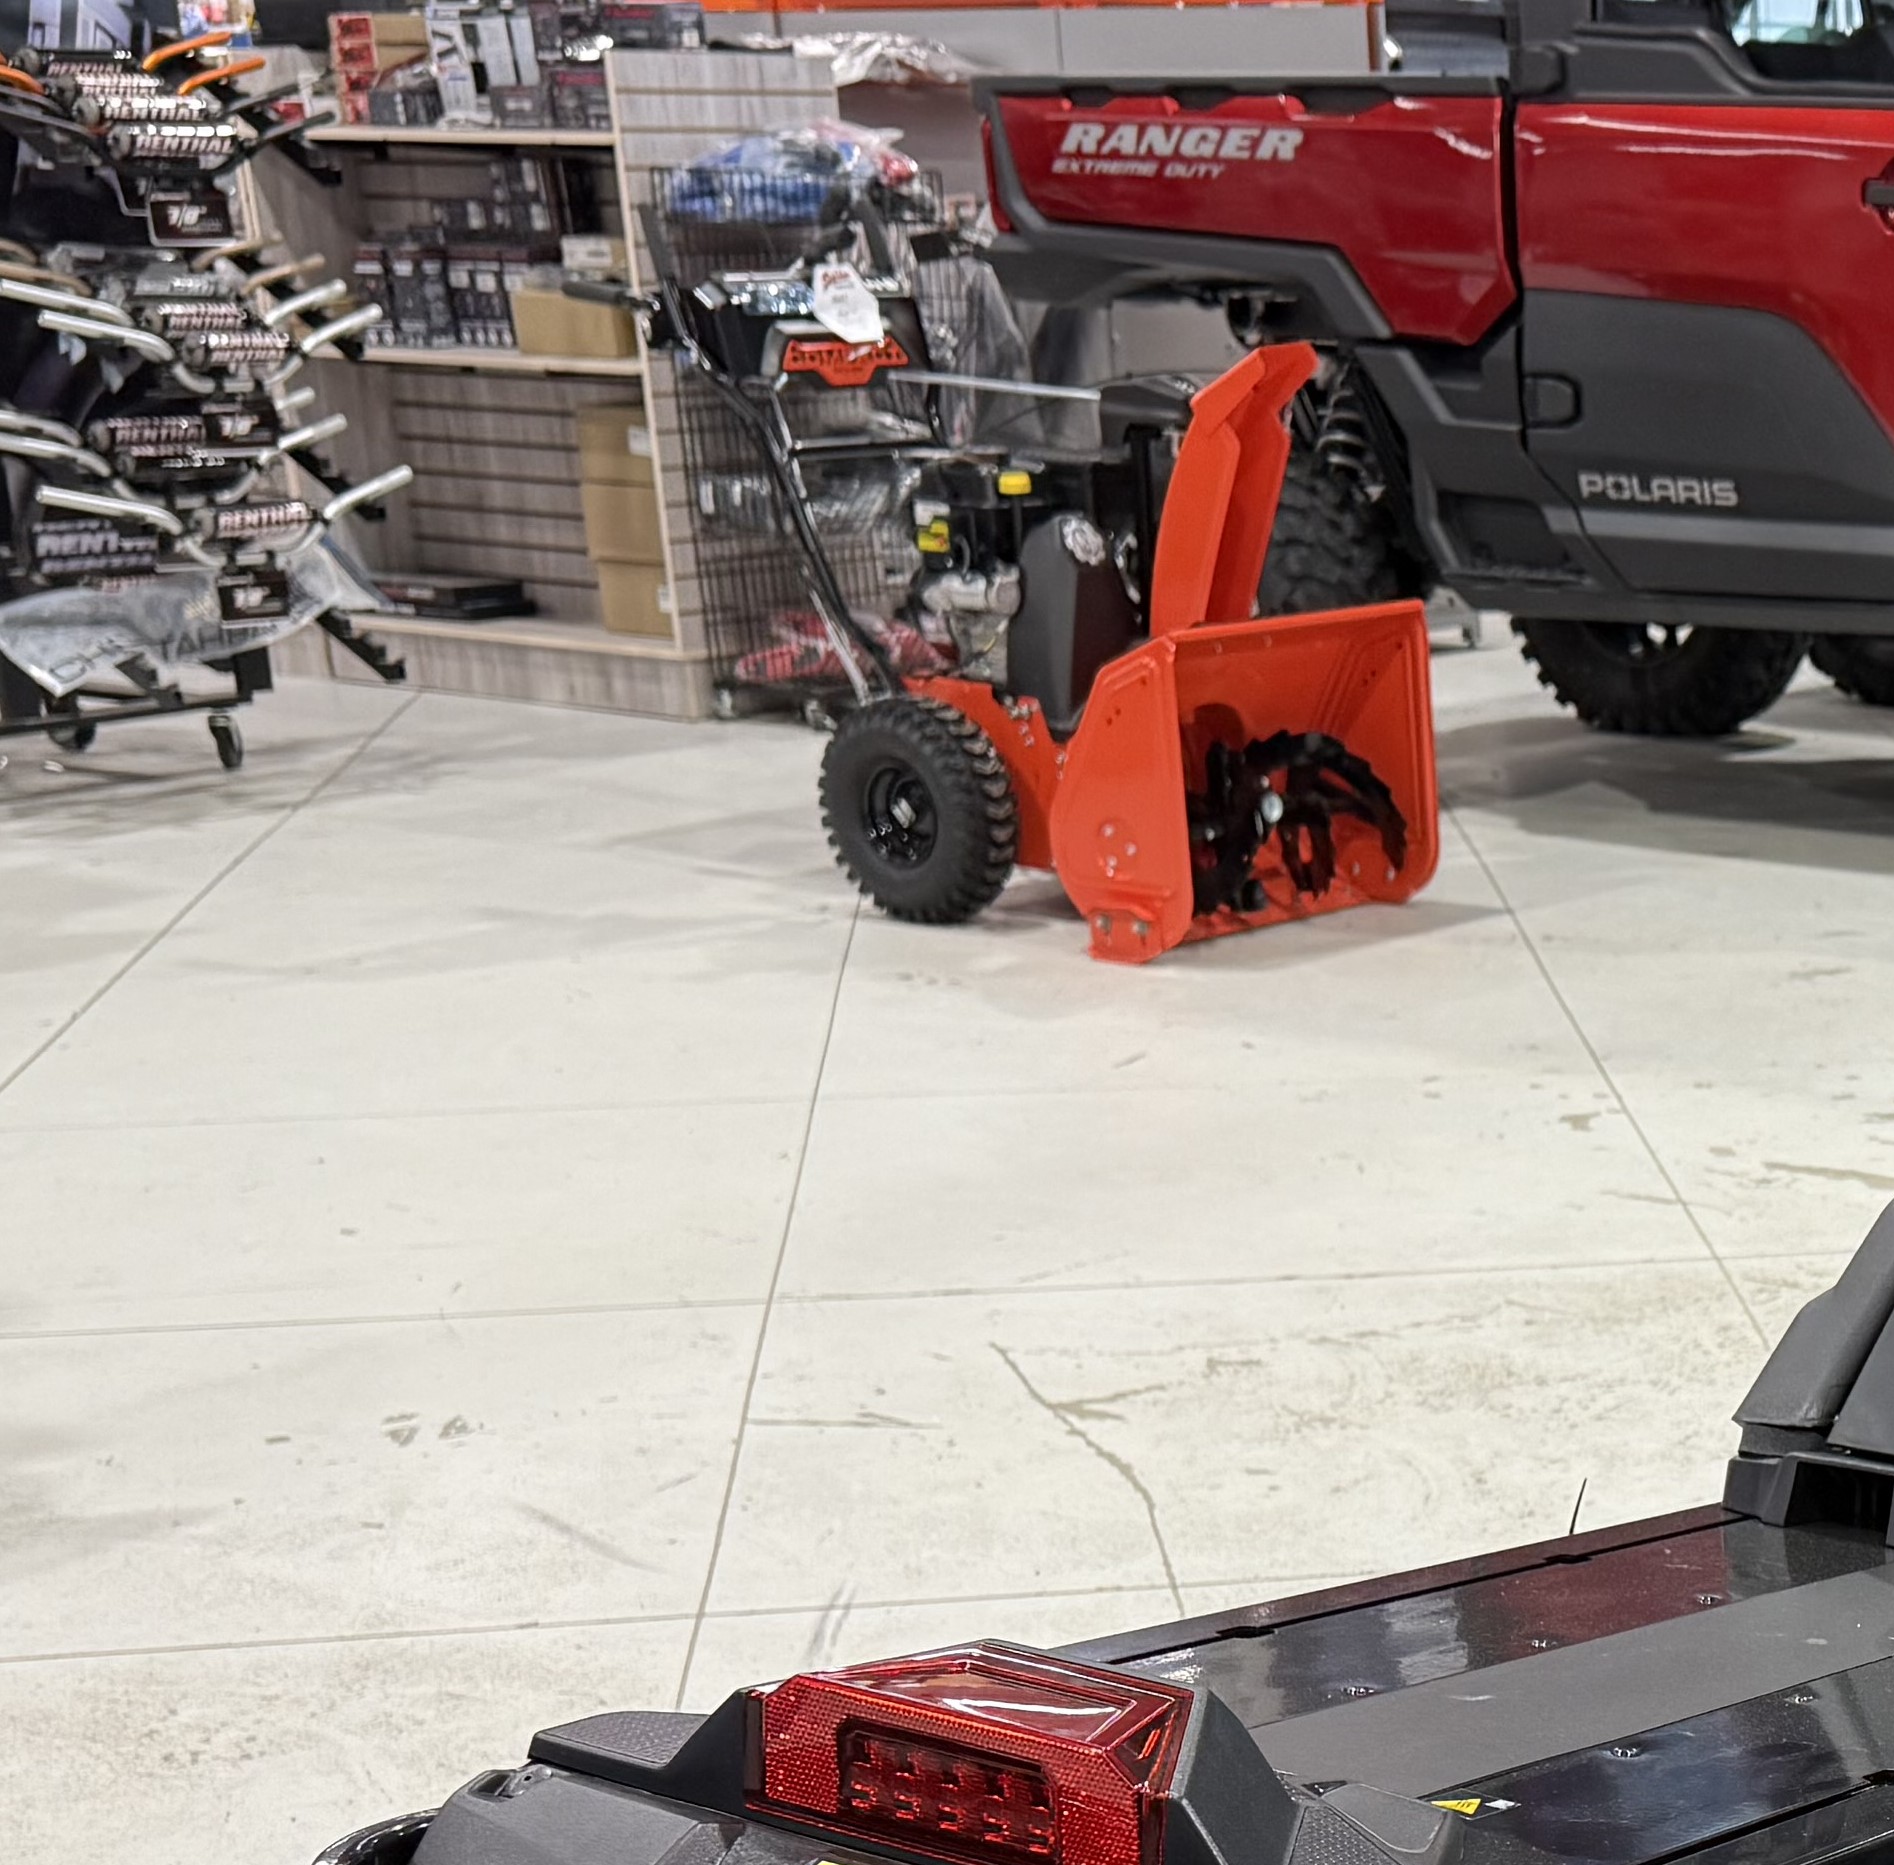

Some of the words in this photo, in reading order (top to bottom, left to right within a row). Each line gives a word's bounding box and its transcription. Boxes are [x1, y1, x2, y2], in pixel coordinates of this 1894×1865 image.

[1060, 121, 1304, 161] RANGER
[1051, 157, 1160, 178] EXTREME
[1163, 160, 1226, 181] DUTY
[1577, 470, 1739, 508] POLARIS
